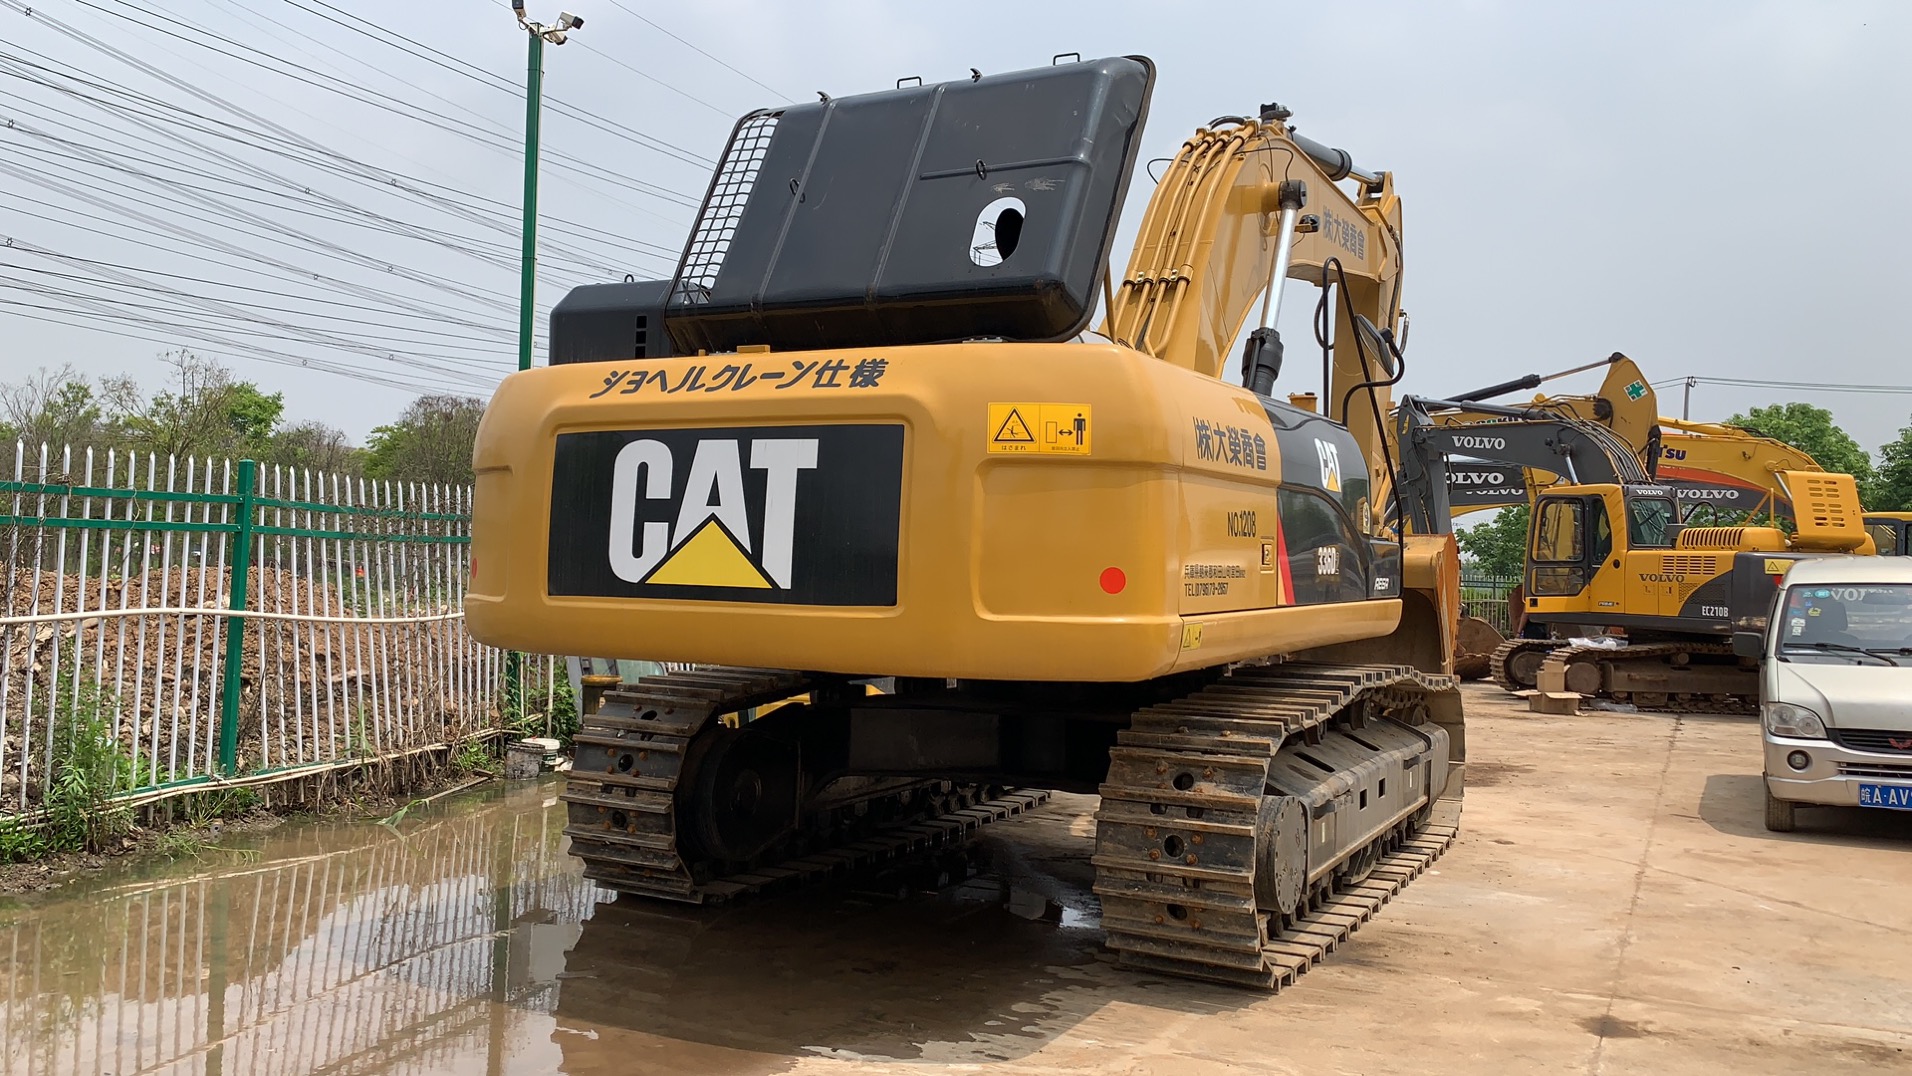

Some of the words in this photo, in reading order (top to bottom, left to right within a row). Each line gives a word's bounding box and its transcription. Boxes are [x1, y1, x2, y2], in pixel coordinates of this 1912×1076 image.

[1452, 435, 1506, 450] VOLVO
[1314, 437, 1342, 493] CAT
[1445, 472, 1505, 485] OLVO
[1677, 489, 1740, 499] VOLVO
[609, 438, 819, 590] CAT
[1227, 510, 1257, 538] NO.1208
[1639, 573, 1685, 583] VOLVO
[1702, 605, 1729, 618] EC210B
